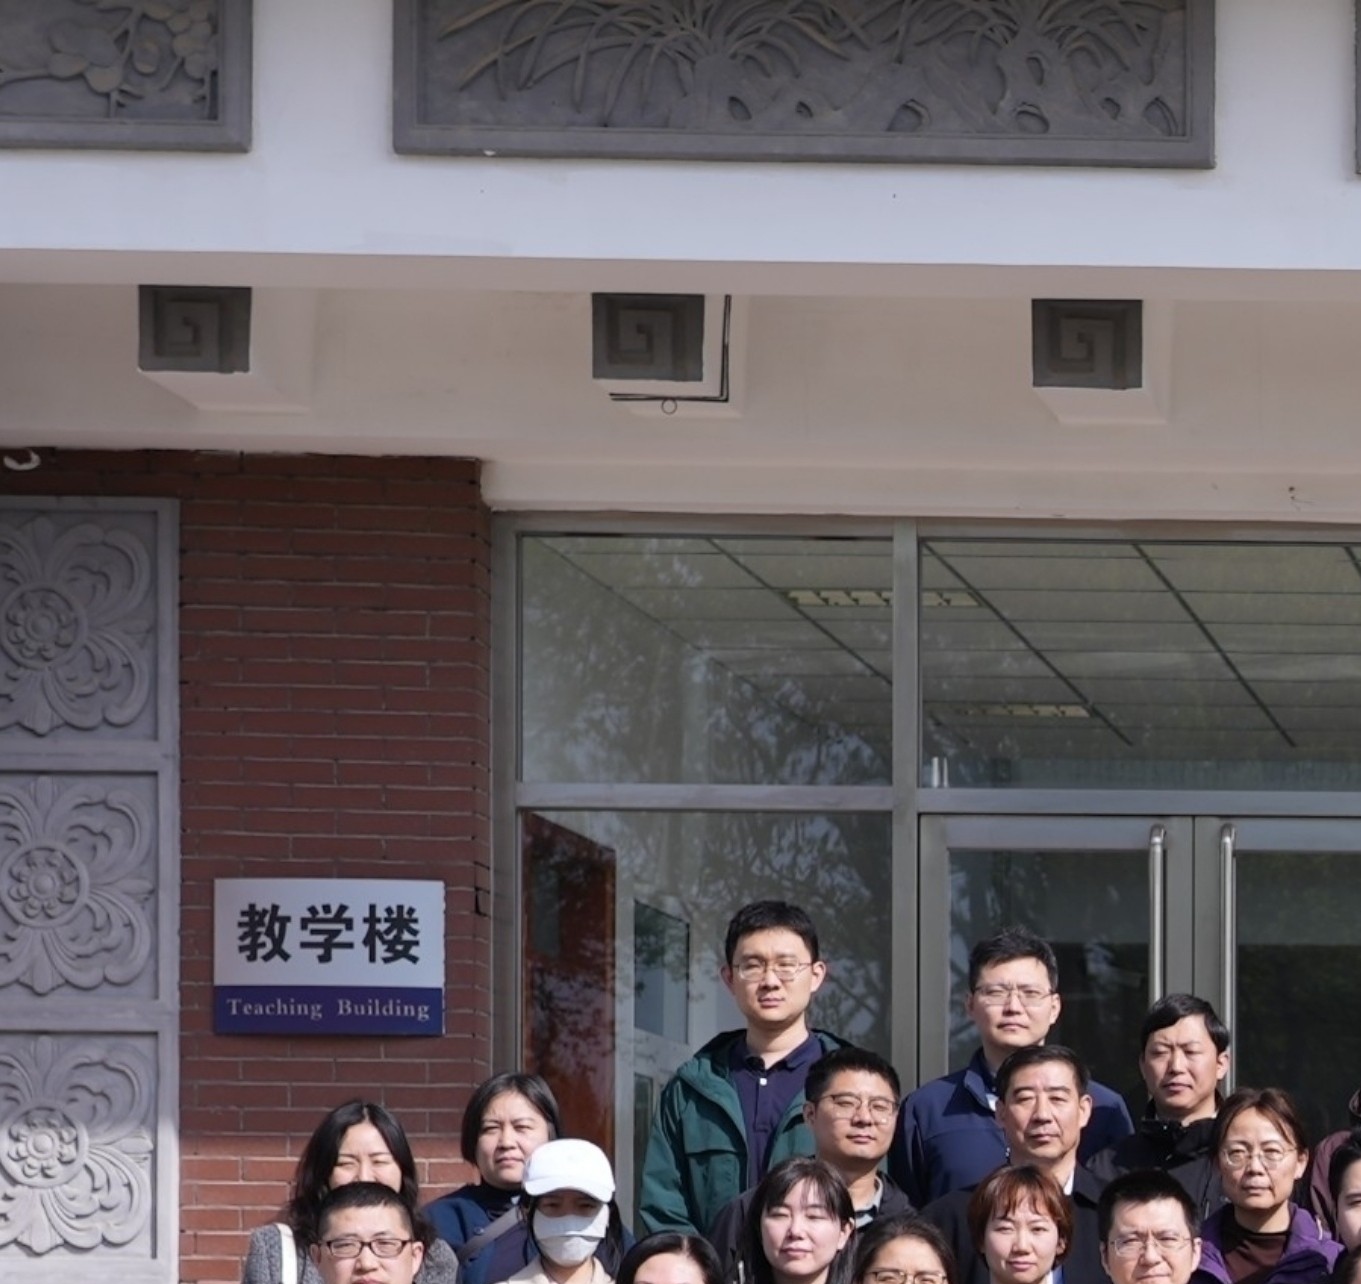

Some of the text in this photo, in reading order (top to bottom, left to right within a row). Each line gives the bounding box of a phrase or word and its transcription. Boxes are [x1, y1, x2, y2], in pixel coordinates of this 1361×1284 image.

[237, 902, 421, 965] 教学楼
[226, 997, 431, 1021] Teaching Building
